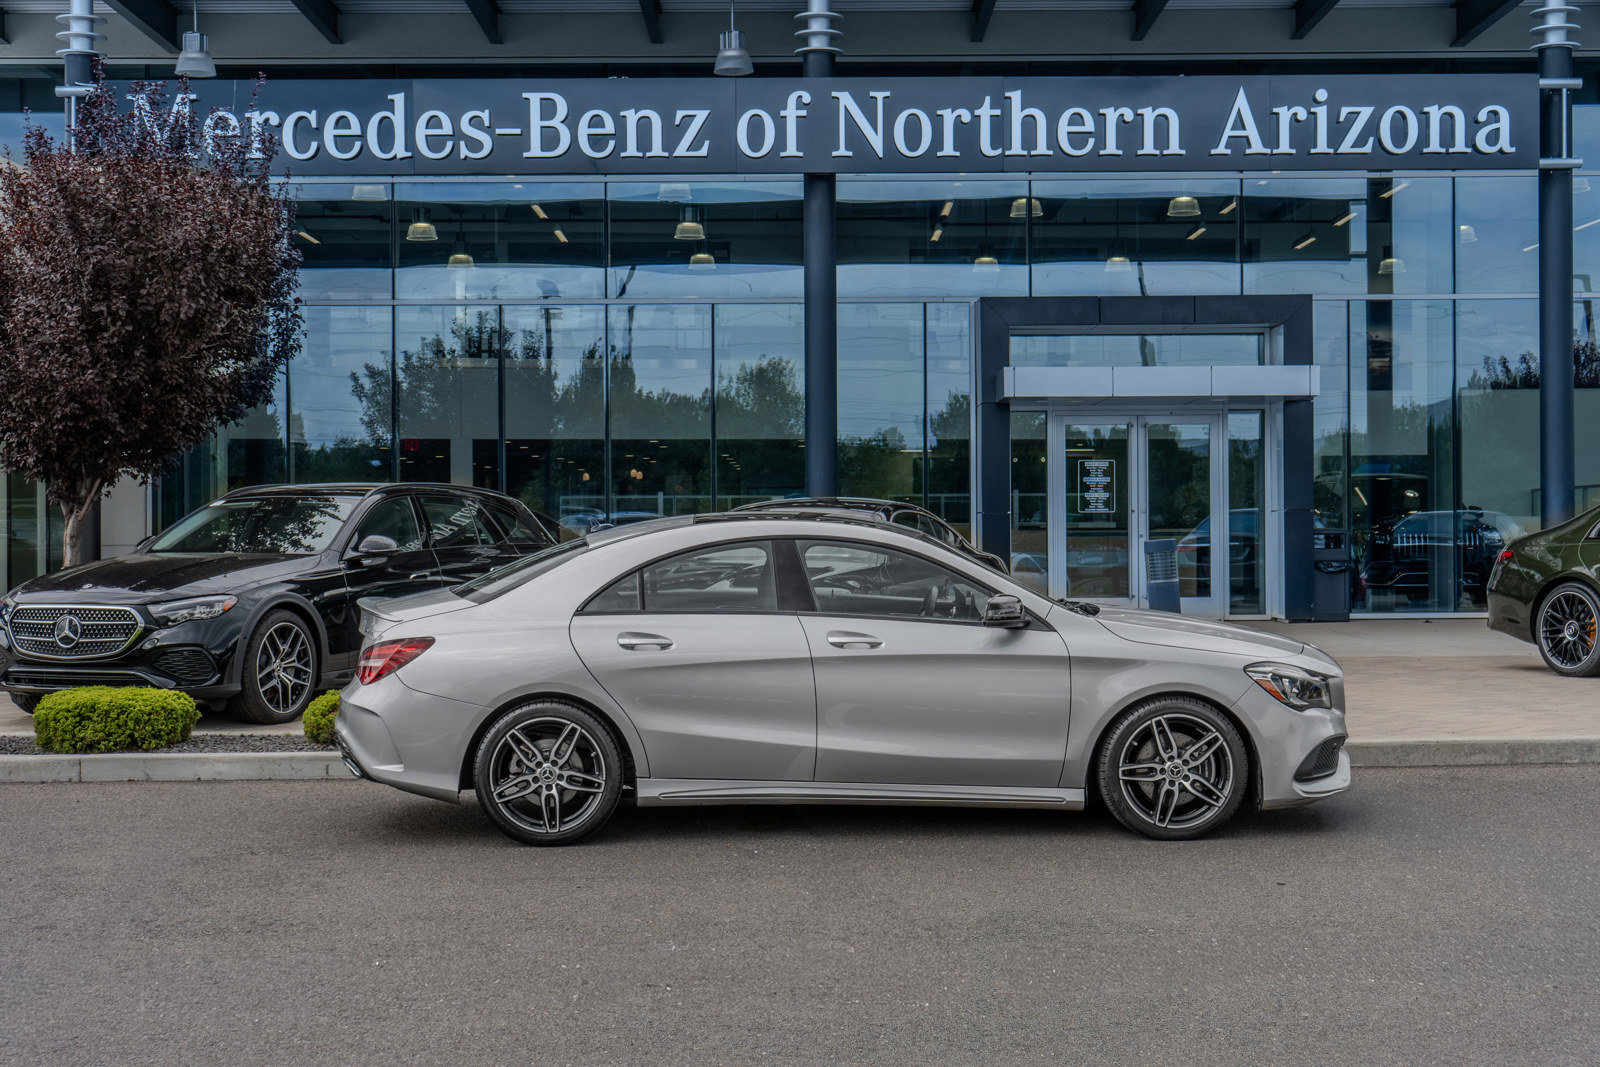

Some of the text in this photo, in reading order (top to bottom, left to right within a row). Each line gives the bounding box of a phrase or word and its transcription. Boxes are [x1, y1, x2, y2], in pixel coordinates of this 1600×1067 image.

[736, 91, 811, 158] of
[831, 89, 1186, 158] Northern
[1210, 86, 1517, 156] Arizona
